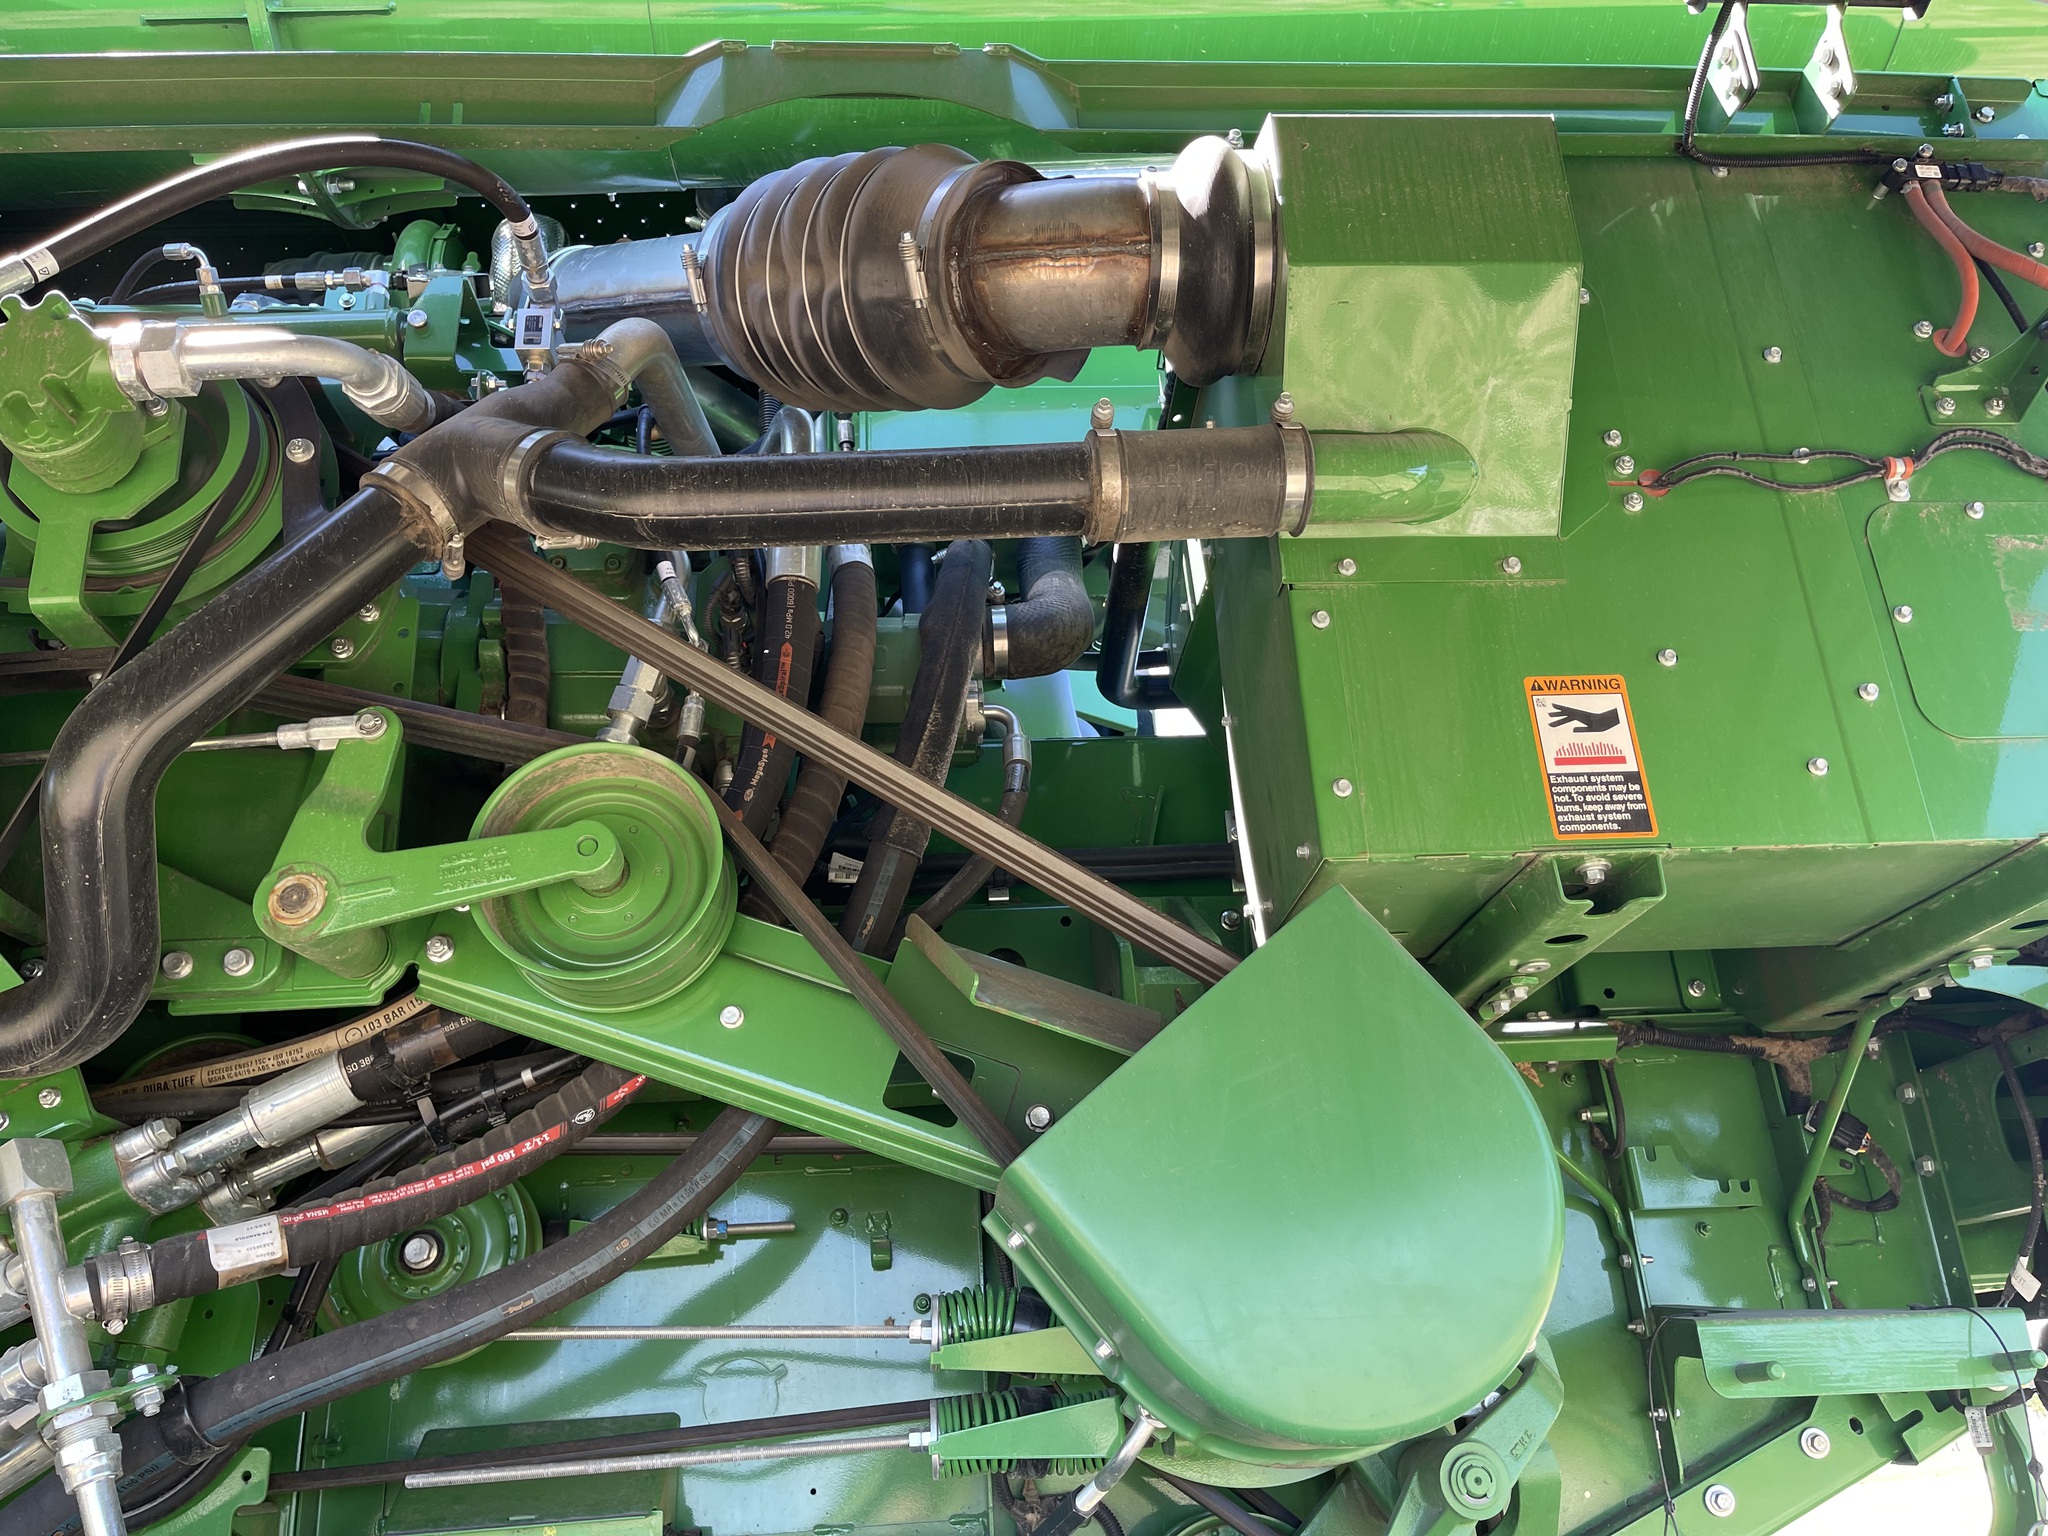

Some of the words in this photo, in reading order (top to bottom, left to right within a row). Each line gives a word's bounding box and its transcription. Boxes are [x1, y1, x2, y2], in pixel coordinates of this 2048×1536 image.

[786, 608, 794, 624] MPa
[784, 625, 793, 639] 42.0
[1544, 678, 1621, 691] WARNING
[1550, 775, 1588, 784] Exhaust
[1590, 774, 1624, 784] system
[1552, 784, 1607, 795] components
[1609, 784, 1627, 794] may
[1629, 782, 1640, 791] be
[1554, 794, 1572, 803] hot.
[1572, 793, 1584, 802] To
[1586, 792, 1611, 802] avoid
[1612, 793, 1643, 801] severe
[1555, 804, 1582, 813] burns,
[1583, 803, 1604, 813] keep
[1604, 803, 1626, 812] away
[1627, 802, 1647, 811] from
[1557, 813, 1596, 822] exhaust
[1597, 812, 1631, 822] system
[1559, 822, 1621, 833] components.
[363, 1019, 382, 1035] 103
[383, 1005, 406, 1024] BAR
[207, 1064, 233, 1077] EXCEEDS
[272, 1052, 284, 1061] ISO
[285, 1047, 304, 1059] 18752
[208, 1073, 227, 1084] MSHA
[257, 1064, 270, 1073] ABS
[276, 1058, 290, 1068] DNV
[497, 1150, 516, 1162] 160
[481, 1156, 496, 1171] psi
[306, 1209, 329, 1219] MSHA
[235, 1232, 262, 1242] MANIFOLD
[508, 1297, 535, 1314] Parker
[139, 1464, 160, 1481] PSI)
